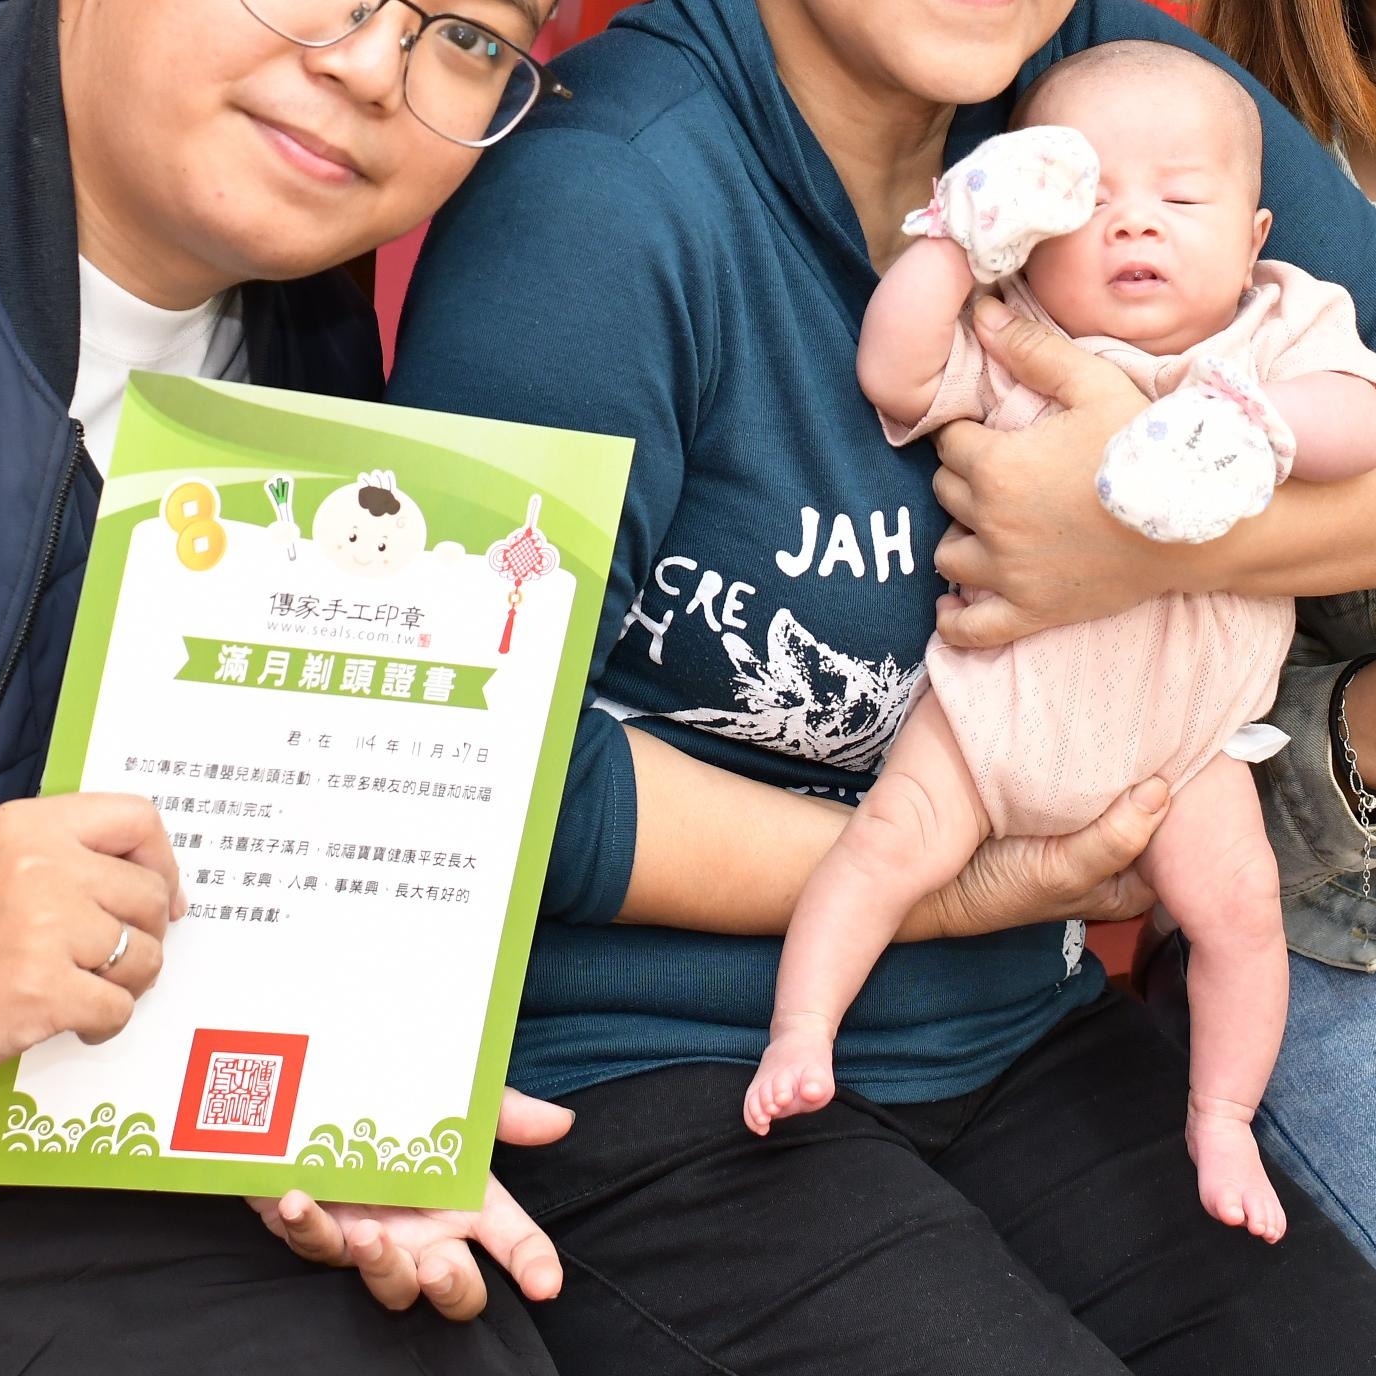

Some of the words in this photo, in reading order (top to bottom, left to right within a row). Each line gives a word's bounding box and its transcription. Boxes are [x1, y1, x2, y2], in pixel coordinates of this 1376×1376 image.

[775, 505, 915, 583] JAH
[269, 591, 426, 630] 傳家手工印章
[266, 620, 416, 646] www.seals.com.tw
[214, 644, 457, 703] 滿月剃頭證書
[385, 739, 400, 753] 年
[430, 743, 444, 759] 月
[476, 748, 489, 763] 日
[167, 832, 477, 869] 證書，恭喜孩子滿月，祝福寶寶健康平安長大
